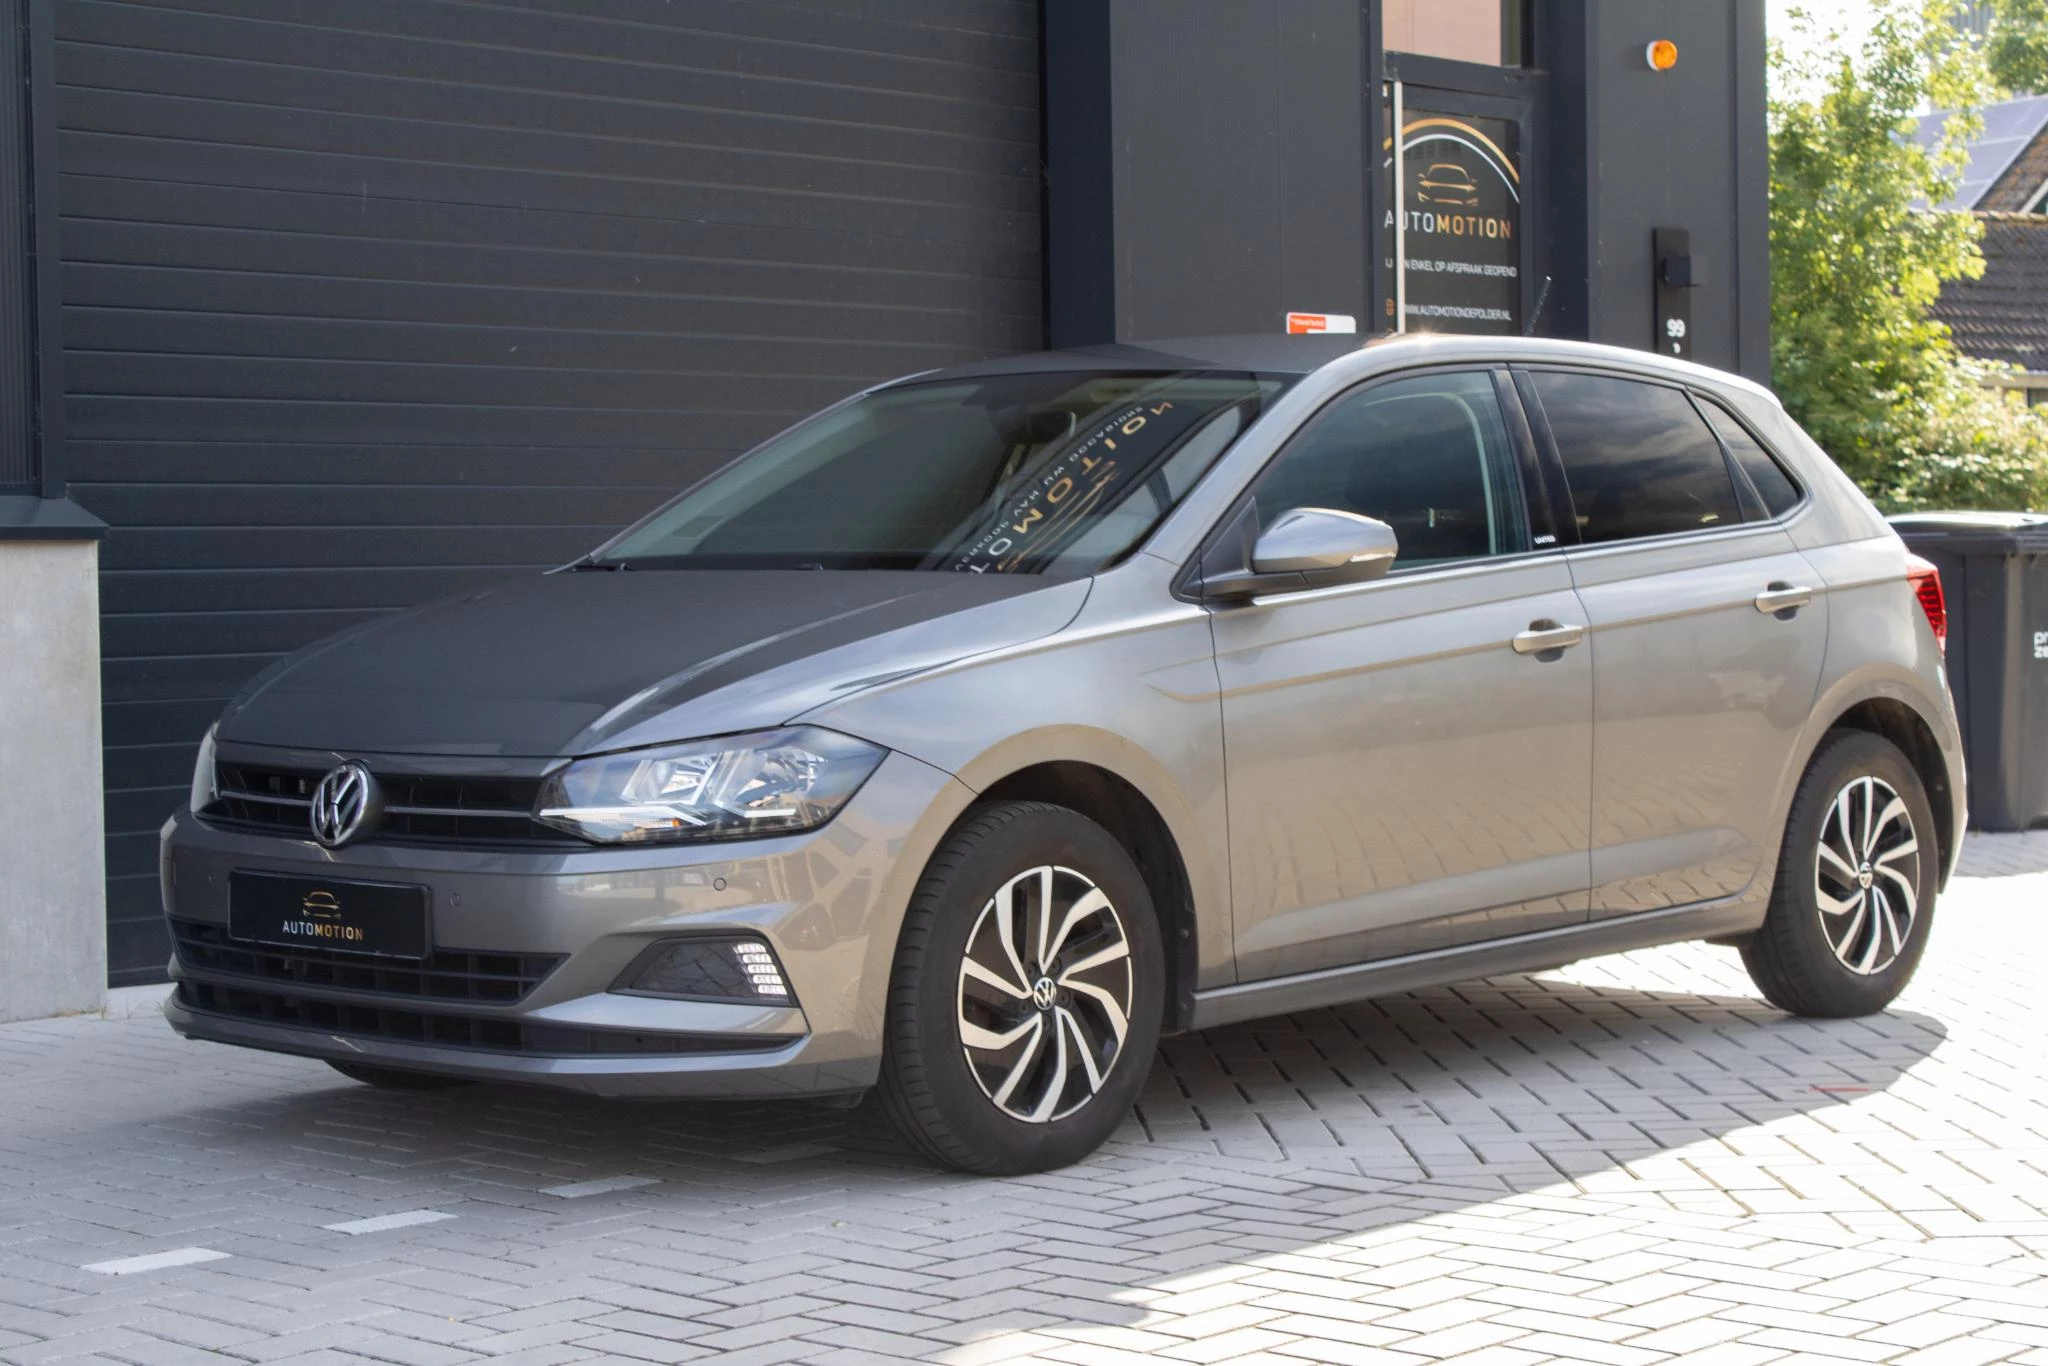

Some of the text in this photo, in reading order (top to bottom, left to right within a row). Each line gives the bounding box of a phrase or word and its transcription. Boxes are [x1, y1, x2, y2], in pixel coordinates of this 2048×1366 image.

[1411, 258, 1434, 272] ENKEL
[1434, 261, 1446, 273] OP
[1446, 261, 1484, 275] AFSPRAAK
[1484, 264, 1518, 278] GEOPEND
[1666, 318, 1686, 338] 99
[282, 919, 364, 942] AUTOMOTION
